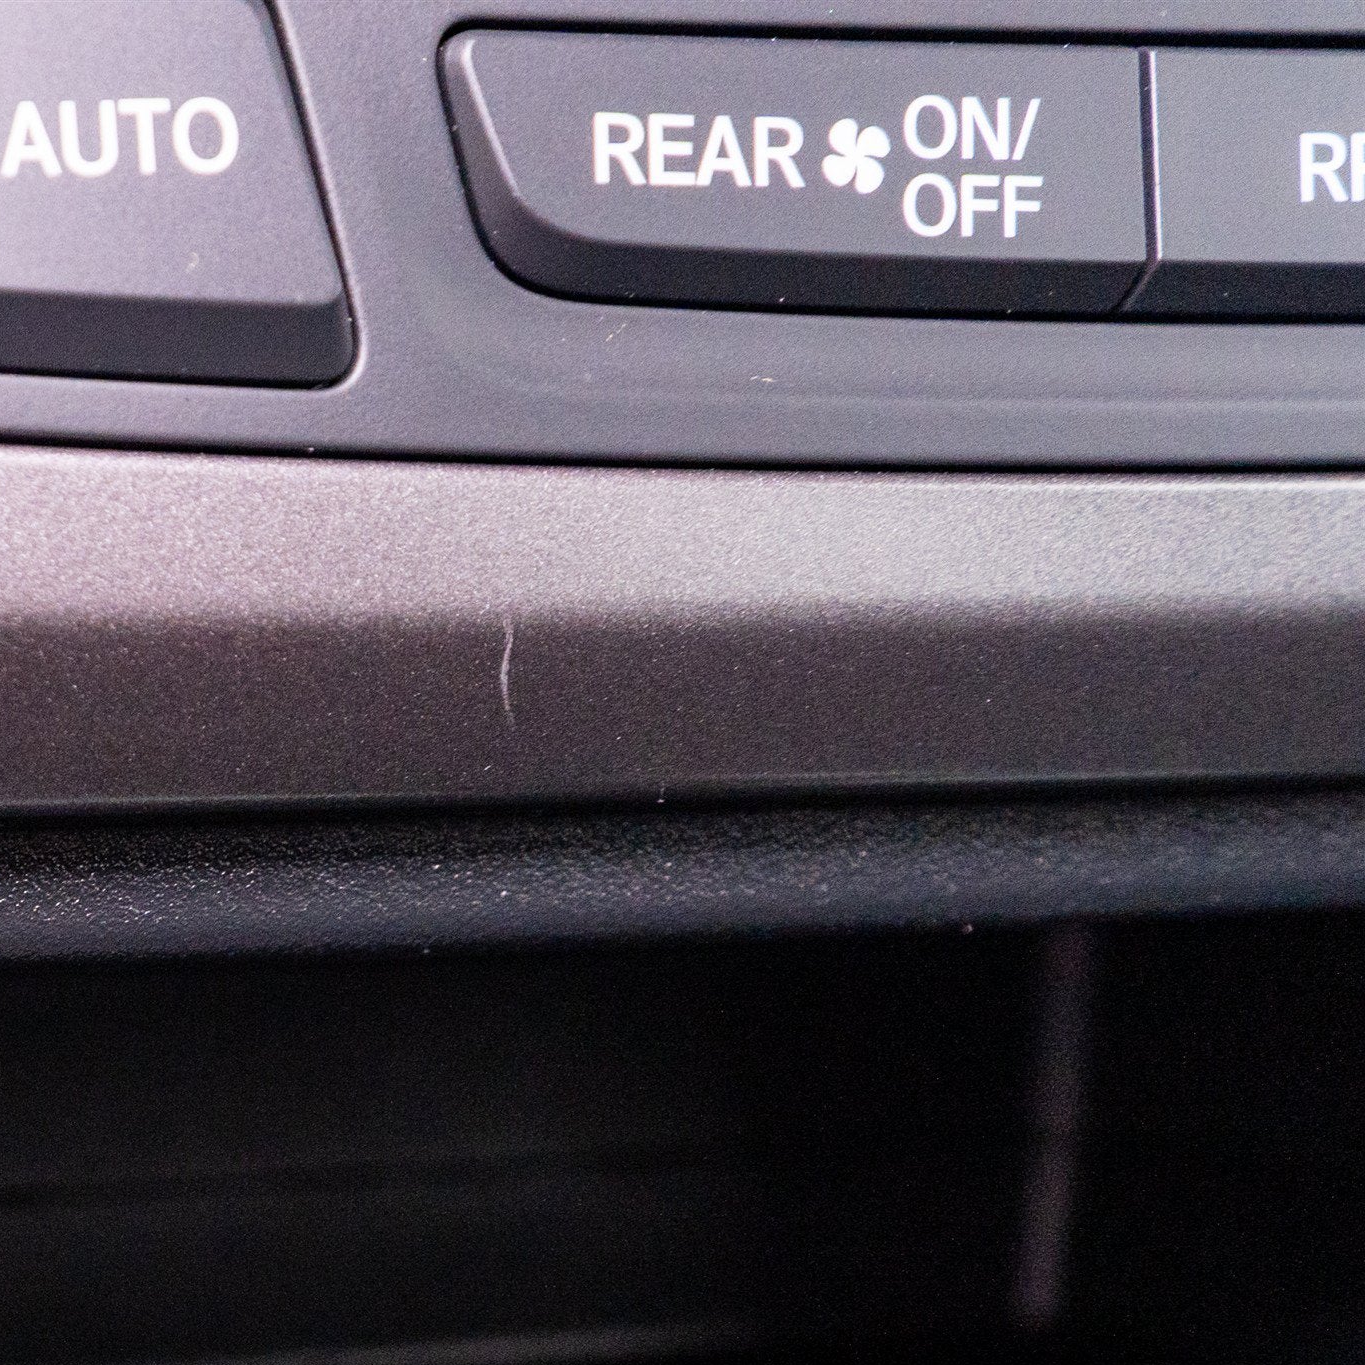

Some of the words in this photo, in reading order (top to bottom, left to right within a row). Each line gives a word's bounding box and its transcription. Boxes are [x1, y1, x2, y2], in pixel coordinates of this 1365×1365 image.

[0, 97, 239, 177] AUTO
[592, 111, 805, 189] REAR
[903, 94, 1041, 161] ON/
[1298, 130, 1365, 203] R
[902, 172, 1044, 239] OFF
